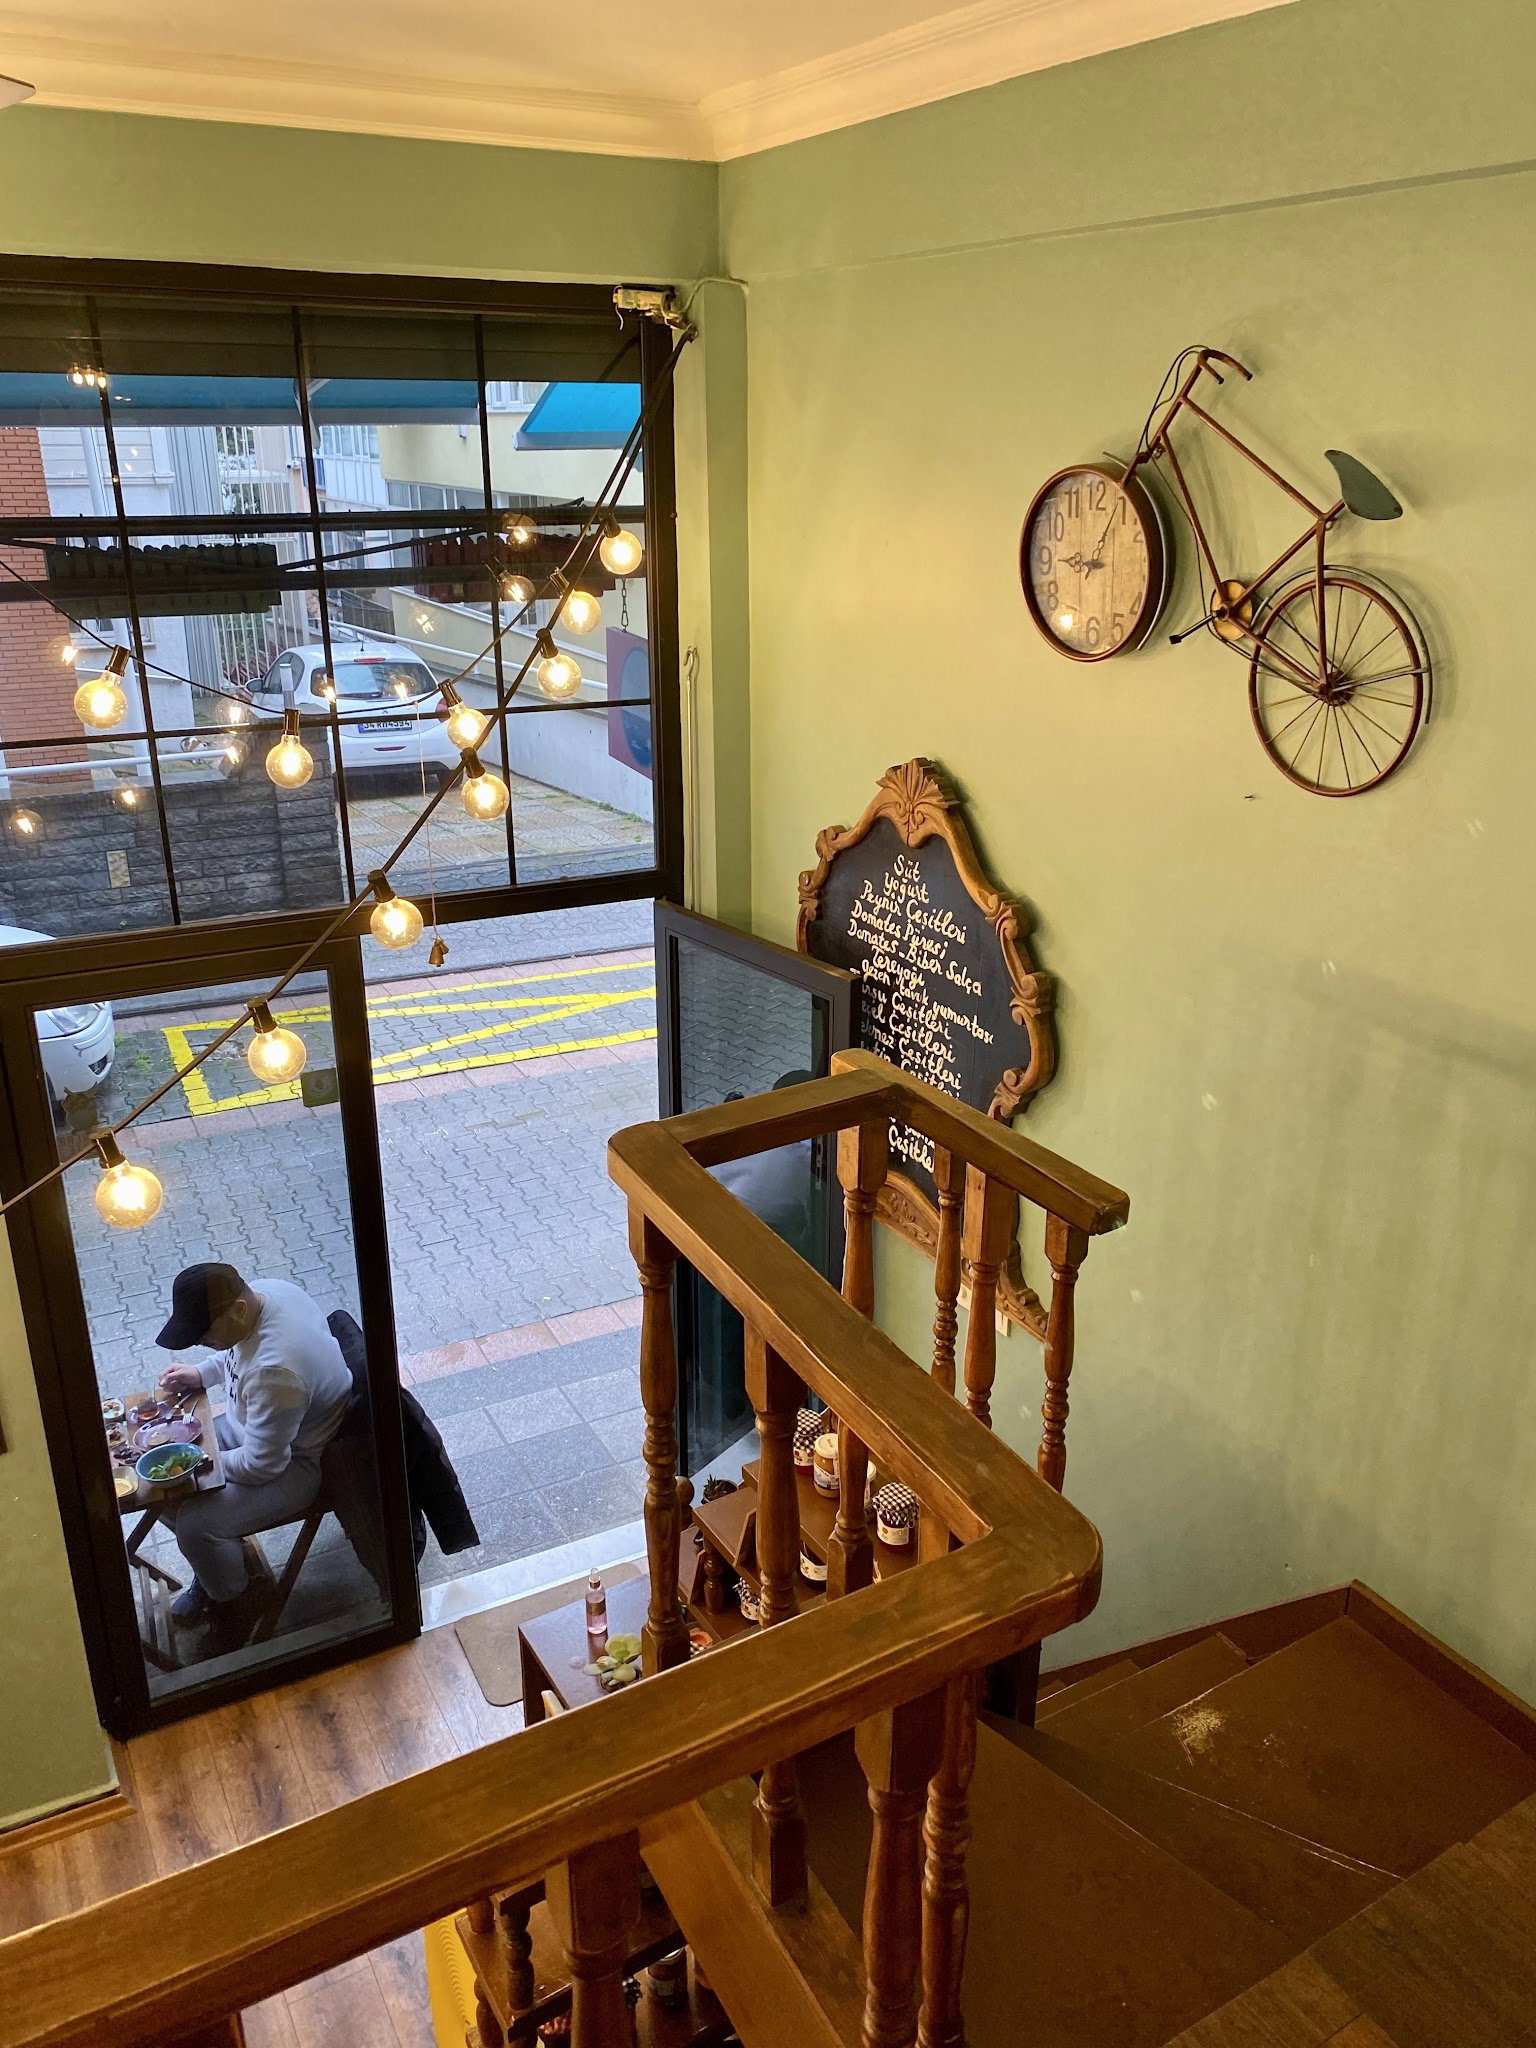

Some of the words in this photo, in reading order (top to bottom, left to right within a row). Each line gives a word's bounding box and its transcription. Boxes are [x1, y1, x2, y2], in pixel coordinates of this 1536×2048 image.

[1064, 487, 1080, 519] 11
[1086, 480, 1106, 511] 12
[1119, 495, 1127, 525] 1
[1048, 510, 1064, 542] 10
[1039, 546, 1052, 575] 9
[1047, 580, 1058, 611] 8
[1129, 592, 1143, 615] 4
[1085, 616, 1100, 647] 6
[1111, 612, 1124, 644] 5
[894, 854, 920, 882] Süt
[860, 880, 902, 916] Peynir
[906, 899, 967, 944] Çeşitleri
[851, 900, 901, 938] Domates
[902, 922, 948, 960] Püresi
[871, 945, 925, 990] Tereyağı
[946, 960, 982, 996] Salça
[861, 1000, 886, 1024] eçel
[892, 992, 951, 1039] Çeşitleri
[899, 1037, 962, 1089] Çeşitleri
[888, 1125, 935, 1173] Çeşitle
